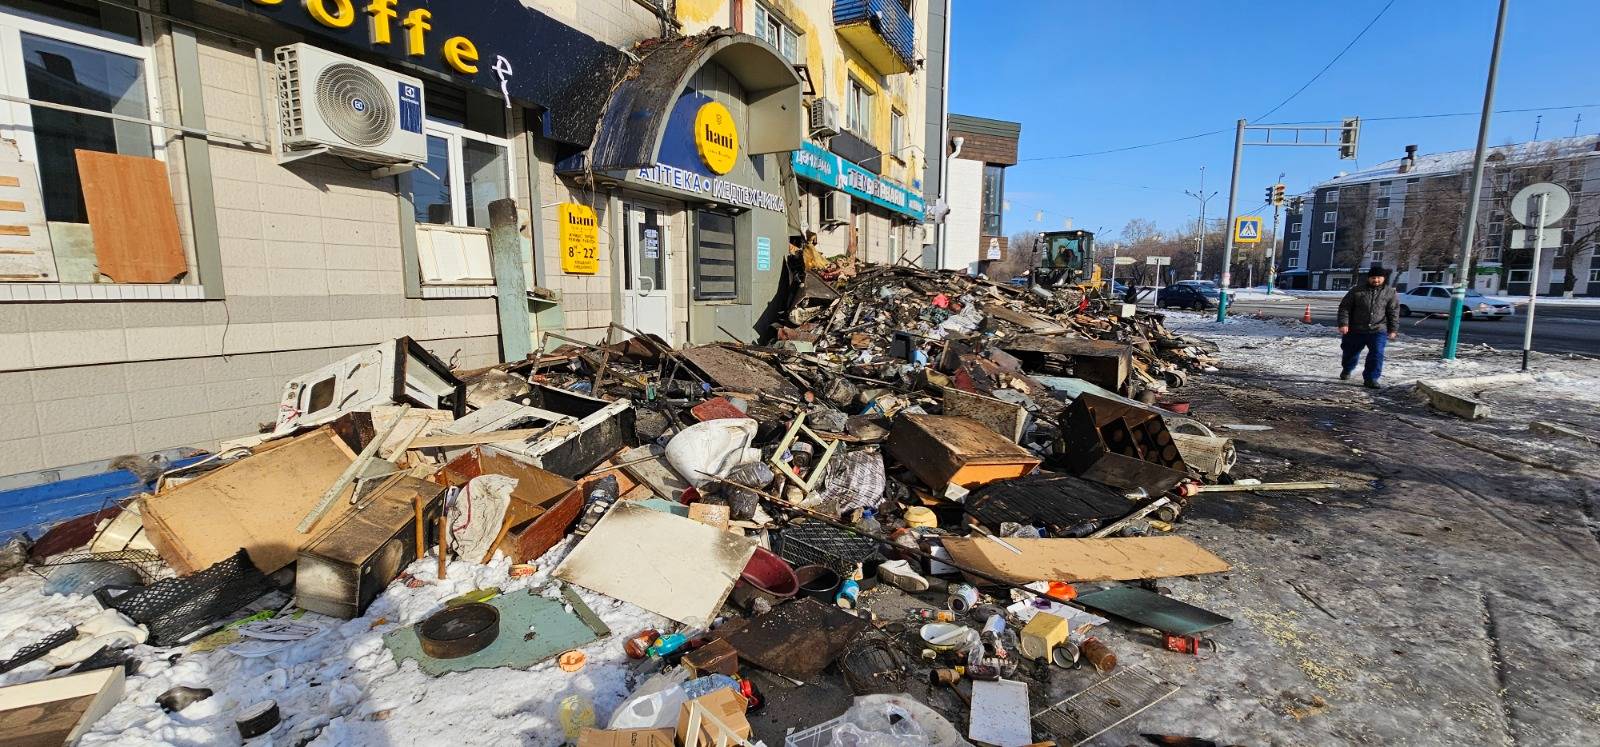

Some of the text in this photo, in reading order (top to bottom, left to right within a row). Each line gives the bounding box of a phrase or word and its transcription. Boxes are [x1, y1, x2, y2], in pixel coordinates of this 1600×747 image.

[705, 123, 733, 150] hani
[637, 163, 785, 213] АПТЕКА МЕДТЕХНИКА
[568, 212, 594, 227] hani
